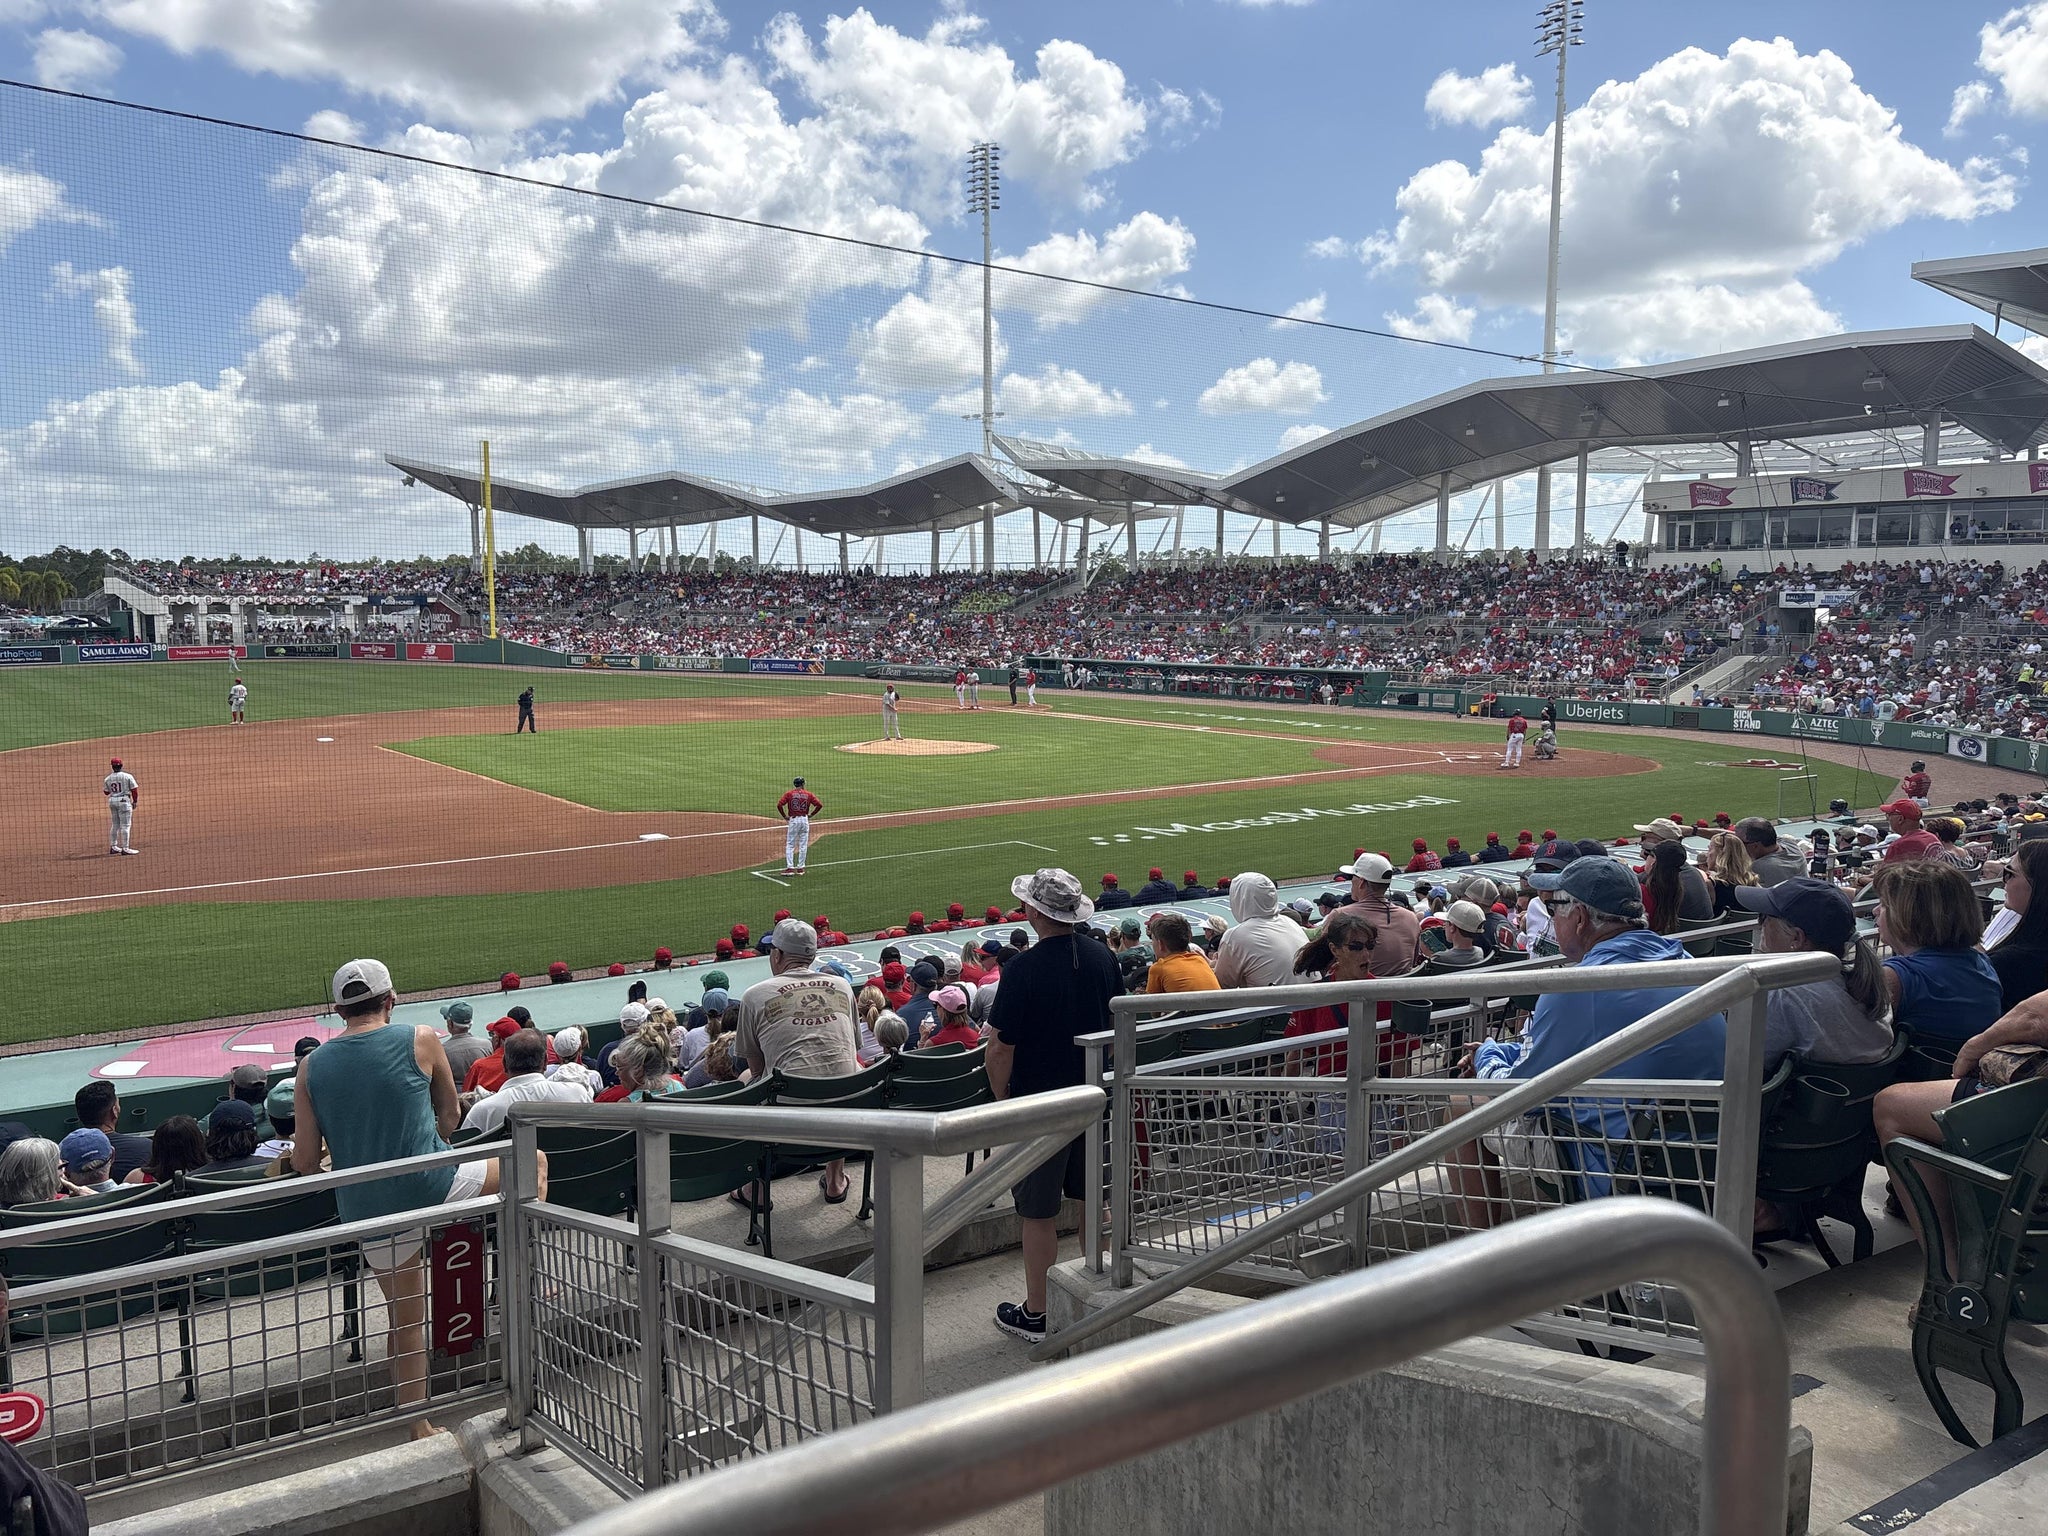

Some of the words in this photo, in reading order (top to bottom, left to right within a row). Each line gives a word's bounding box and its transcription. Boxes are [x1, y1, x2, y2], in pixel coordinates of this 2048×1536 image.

[1797, 482, 1826, 496] 1904
[1913, 476, 1943, 490] 1912
[82, 648, 118, 658] SAMUEL
[119, 646, 149, 656] ADAMS
[1566, 704, 1624, 720] UberJets
[1733, 710, 1752, 720] KICK
[1733, 719, 1761, 730] STAND
[1810, 718, 1839, 729] AZTEC
[1962, 740, 1978, 756] Ford
[110, 782, 122, 792] 31
[1133, 795, 1461, 837] MassMutual
[1544, 842, 1557, 857] B
[777, 982, 806, 995] HULA
[808, 980, 836, 990] GIRL
[792, 1014, 837, 1026] CIGARS
[446, 1240, 472, 1342] 212
[1960, 1296, 1974, 1320] 2
